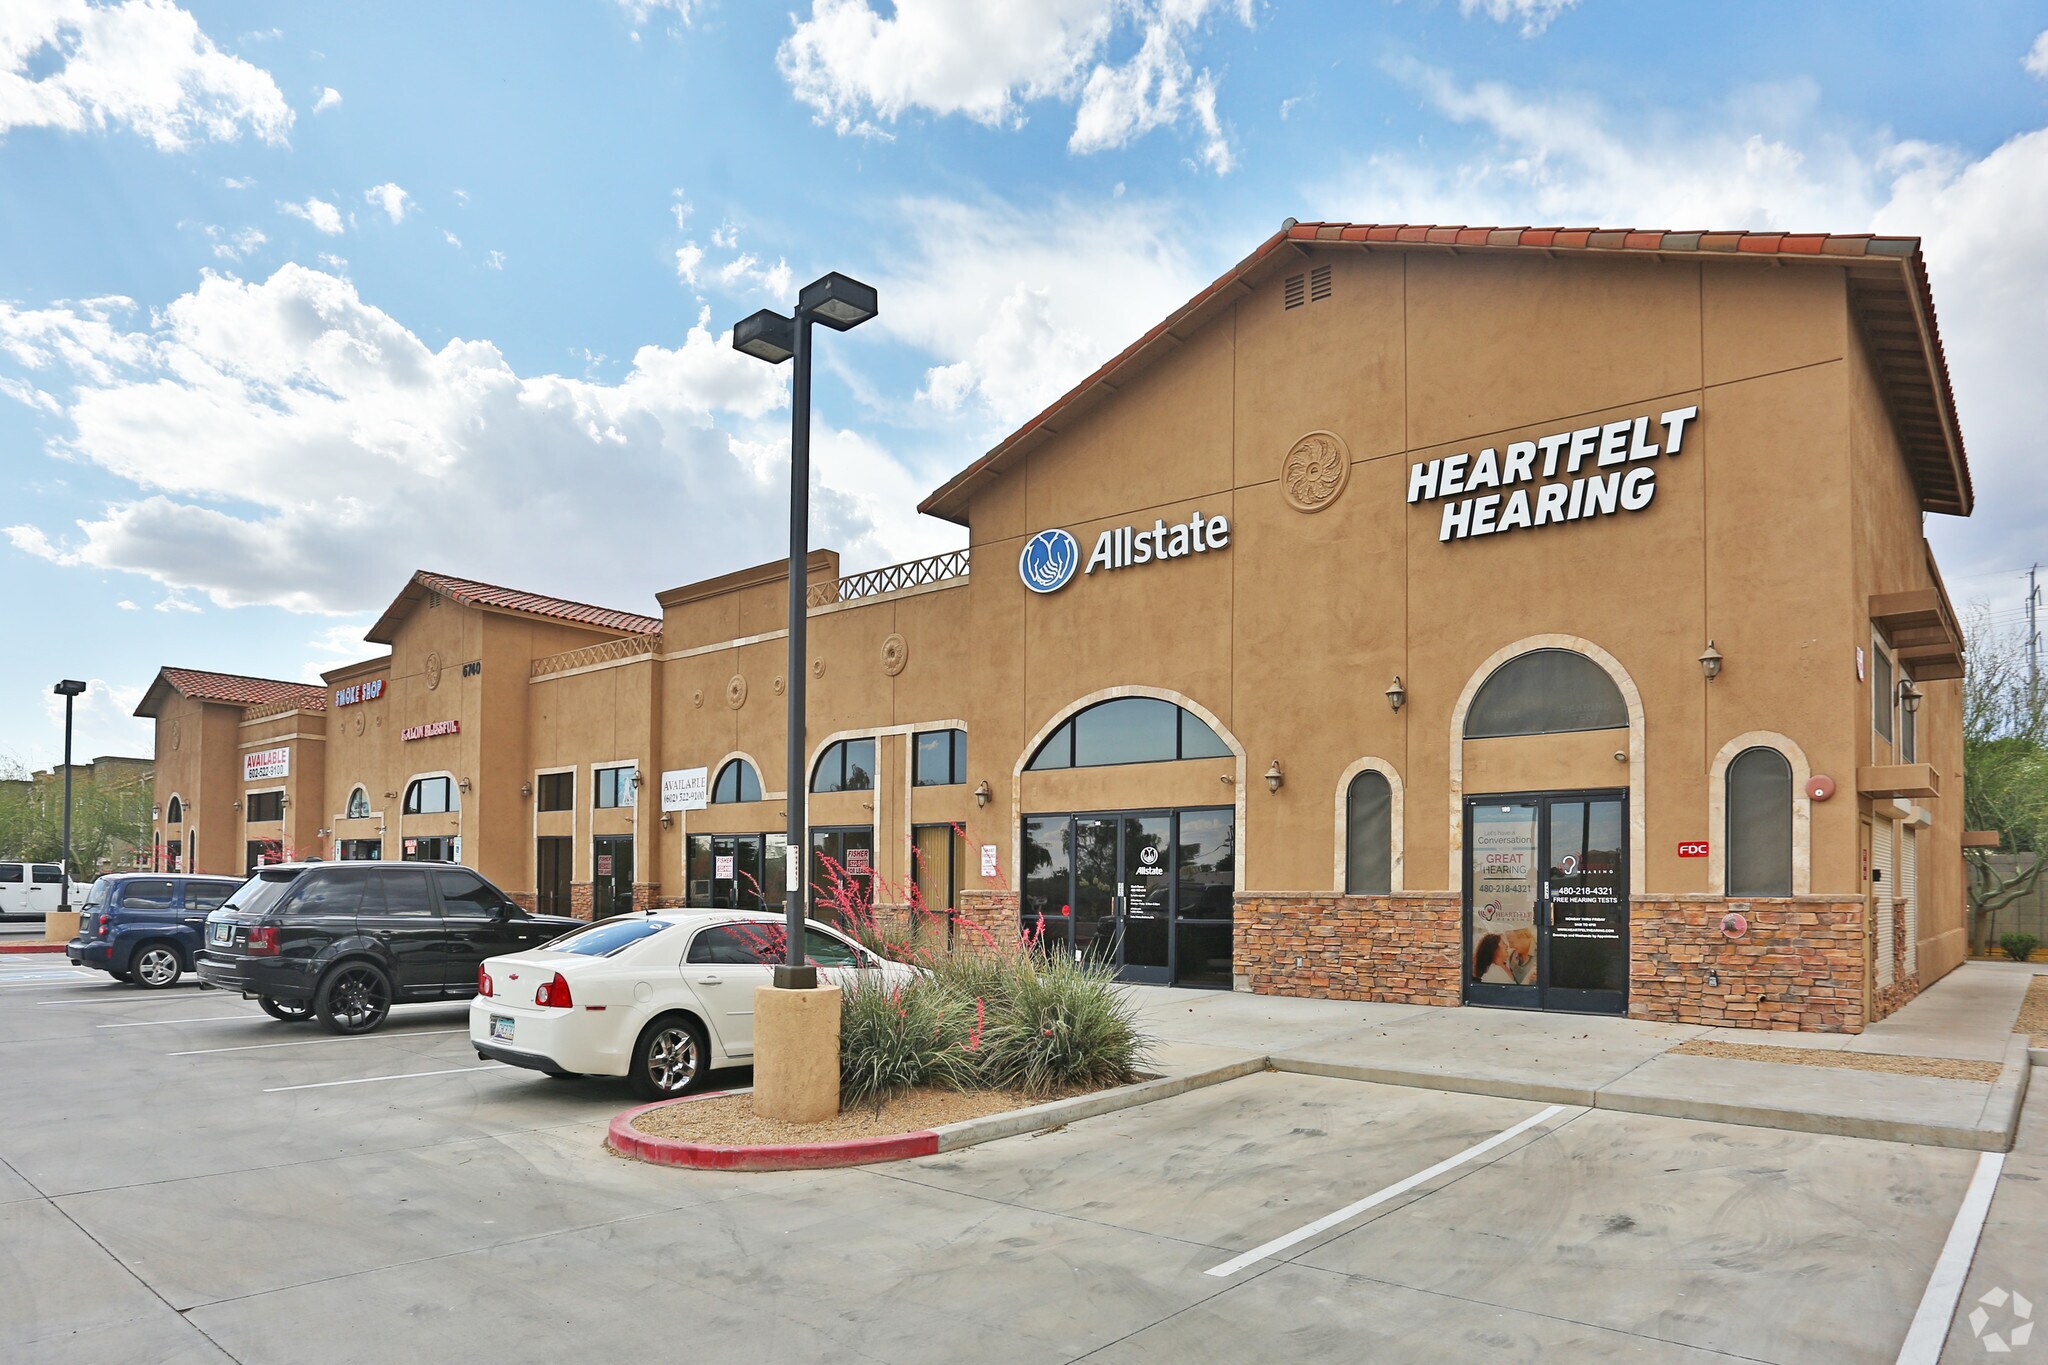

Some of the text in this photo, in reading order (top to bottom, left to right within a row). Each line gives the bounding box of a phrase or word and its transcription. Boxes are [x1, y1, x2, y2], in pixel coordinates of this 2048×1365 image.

[1407, 405, 1697, 503] HEARTFELT
[1439, 466, 1655, 542] HEARING
[1084, 511, 1229, 575] Allstate
[462, 662, 481, 677] 6740
[335, 679, 383, 707] SMOKE SHOP
[401, 724, 424, 742] SALON
[247, 751, 286, 768] AVAILABLE
[249, 765, 284, 778] 602-522-9100
[664, 777, 706, 791] AVAILABLE
[664, 791, 705, 804] (602) 522-9100
[1478, 836, 1532, 844] Conversation
[1680, 844, 1707, 855] FDC
[1486, 854, 1523, 864] GREAT
[1136, 867, 1163, 875] Allstate
[1483, 866, 1527, 875] HEARING
[1479, 885, 1531, 893] 480-218-4321
[1559, 887, 1613, 895] 480-218-4321
